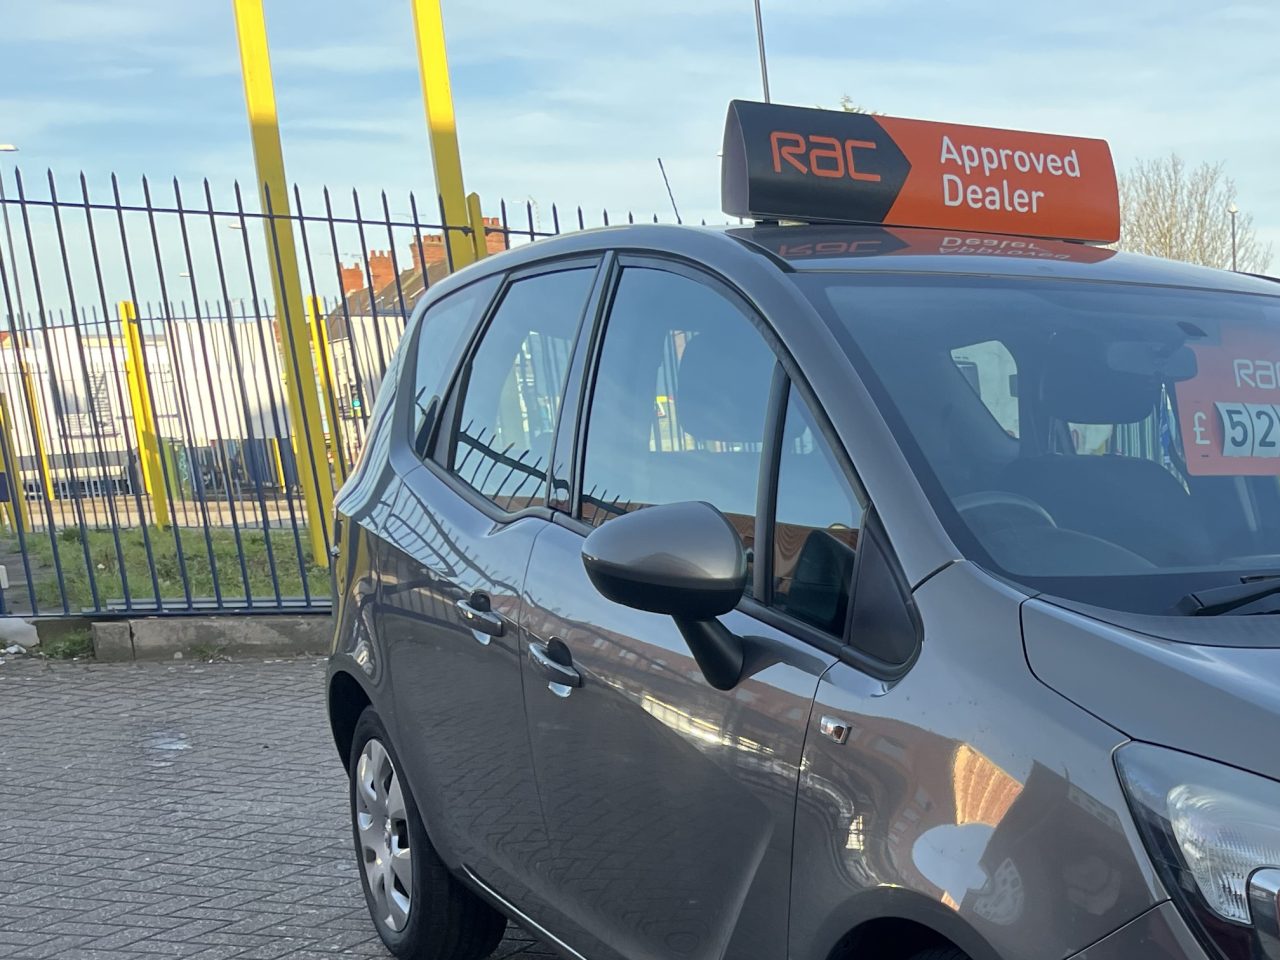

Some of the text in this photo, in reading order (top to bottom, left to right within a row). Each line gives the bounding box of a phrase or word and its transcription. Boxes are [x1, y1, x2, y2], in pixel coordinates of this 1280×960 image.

[940, 135, 1081, 178] Approved
[942, 173, 1045, 214] Dealer
[1192, 411, 1211, 445] £
